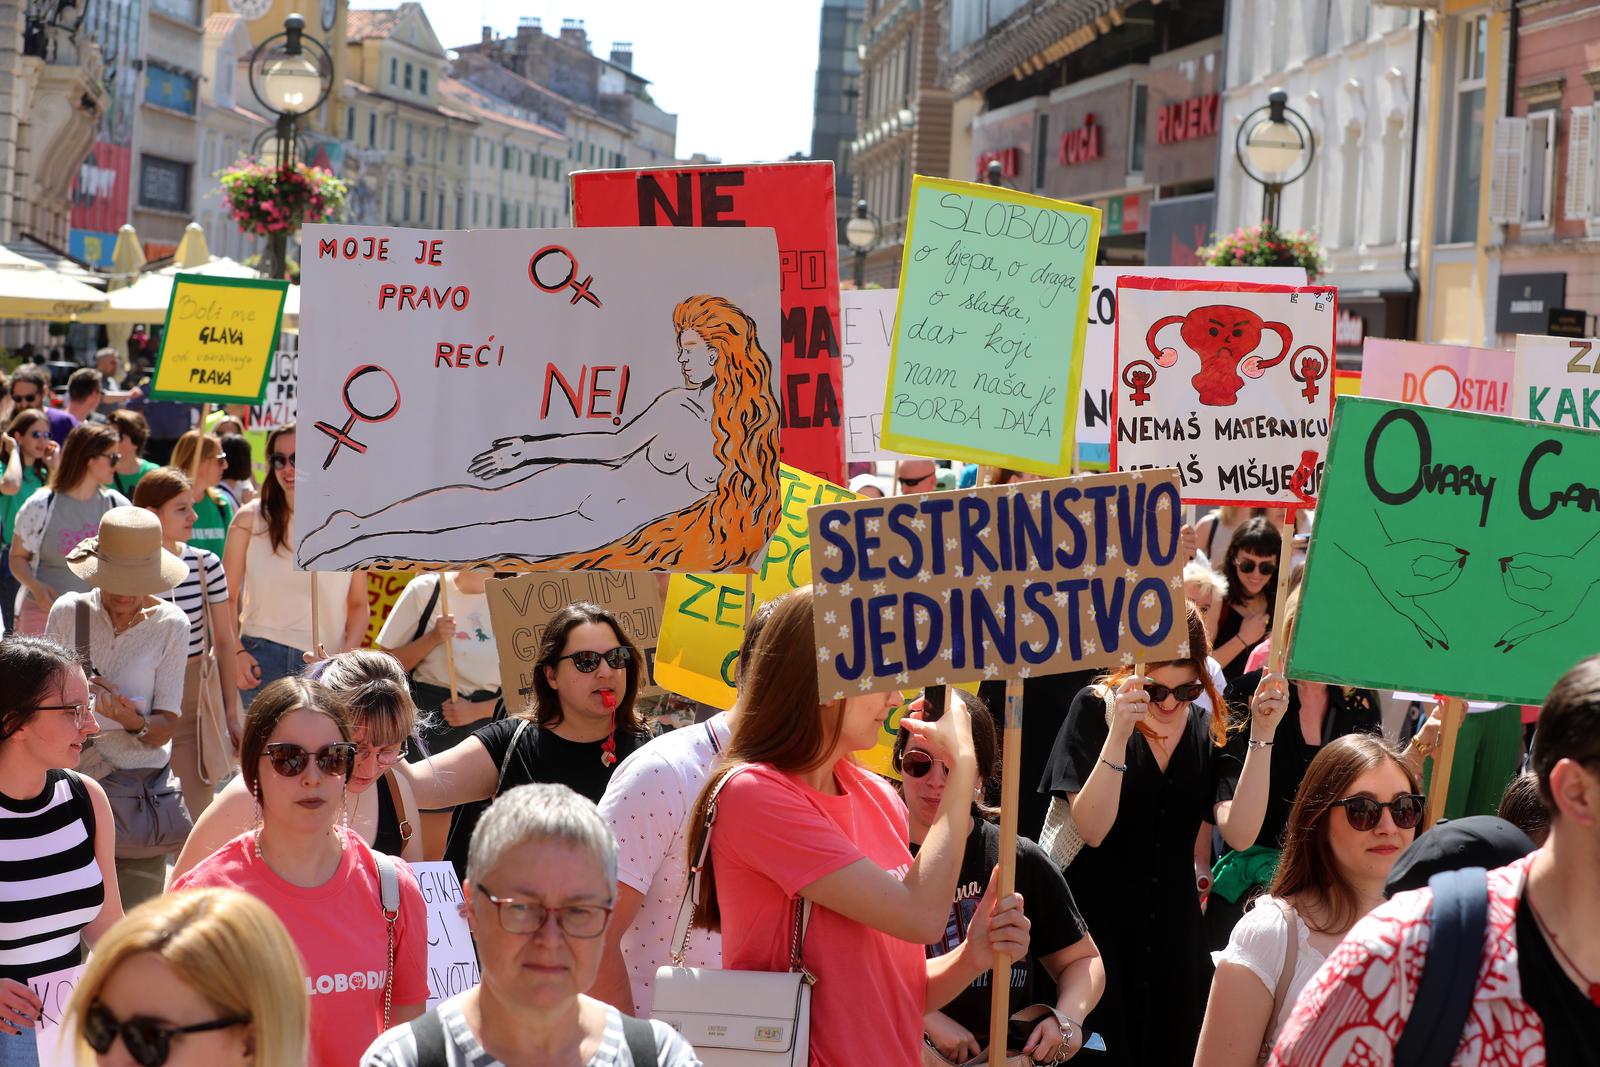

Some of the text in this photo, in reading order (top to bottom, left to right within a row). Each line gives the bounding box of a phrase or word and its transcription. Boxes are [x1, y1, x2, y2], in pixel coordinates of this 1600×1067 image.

[636, 170, 747, 227] NE
[929, 193, 1088, 253] SLOBODO,
[319, 237, 444, 266] MOJE JE
[378, 283, 470, 312] PRAVO
[1030, 263, 1077, 309] draga,
[958, 291, 1031, 325] slatka,
[198, 326, 244, 346] GLAVA
[434, 335, 504, 368] REĆI
[908, 317, 1038, 369] dar koji
[189, 368, 232, 386] PRAVA
[277, 383, 297, 400] PR
[540, 362, 631, 426] NE!
[904, 361, 1057, 424] nam naša je
[1401, 364, 1509, 413] DOSTA!
[890, 394, 1052, 438] BORBA DALA
[1084, 388, 1114, 428] N
[1118, 412, 1328, 444] NEMAŠ MATERNICU
[819, 481, 1182, 584] SESTRINSTVO
[502, 571, 636, 616] VOLIM
[678, 573, 755, 628] ZE
[613, 606, 658, 640] OJI
[835, 576, 1174, 680] JEDINSTVO
[415, 871, 464, 904] GIKA
[953, 881, 981, 903] na
[305, 970, 387, 996] LOBODU
